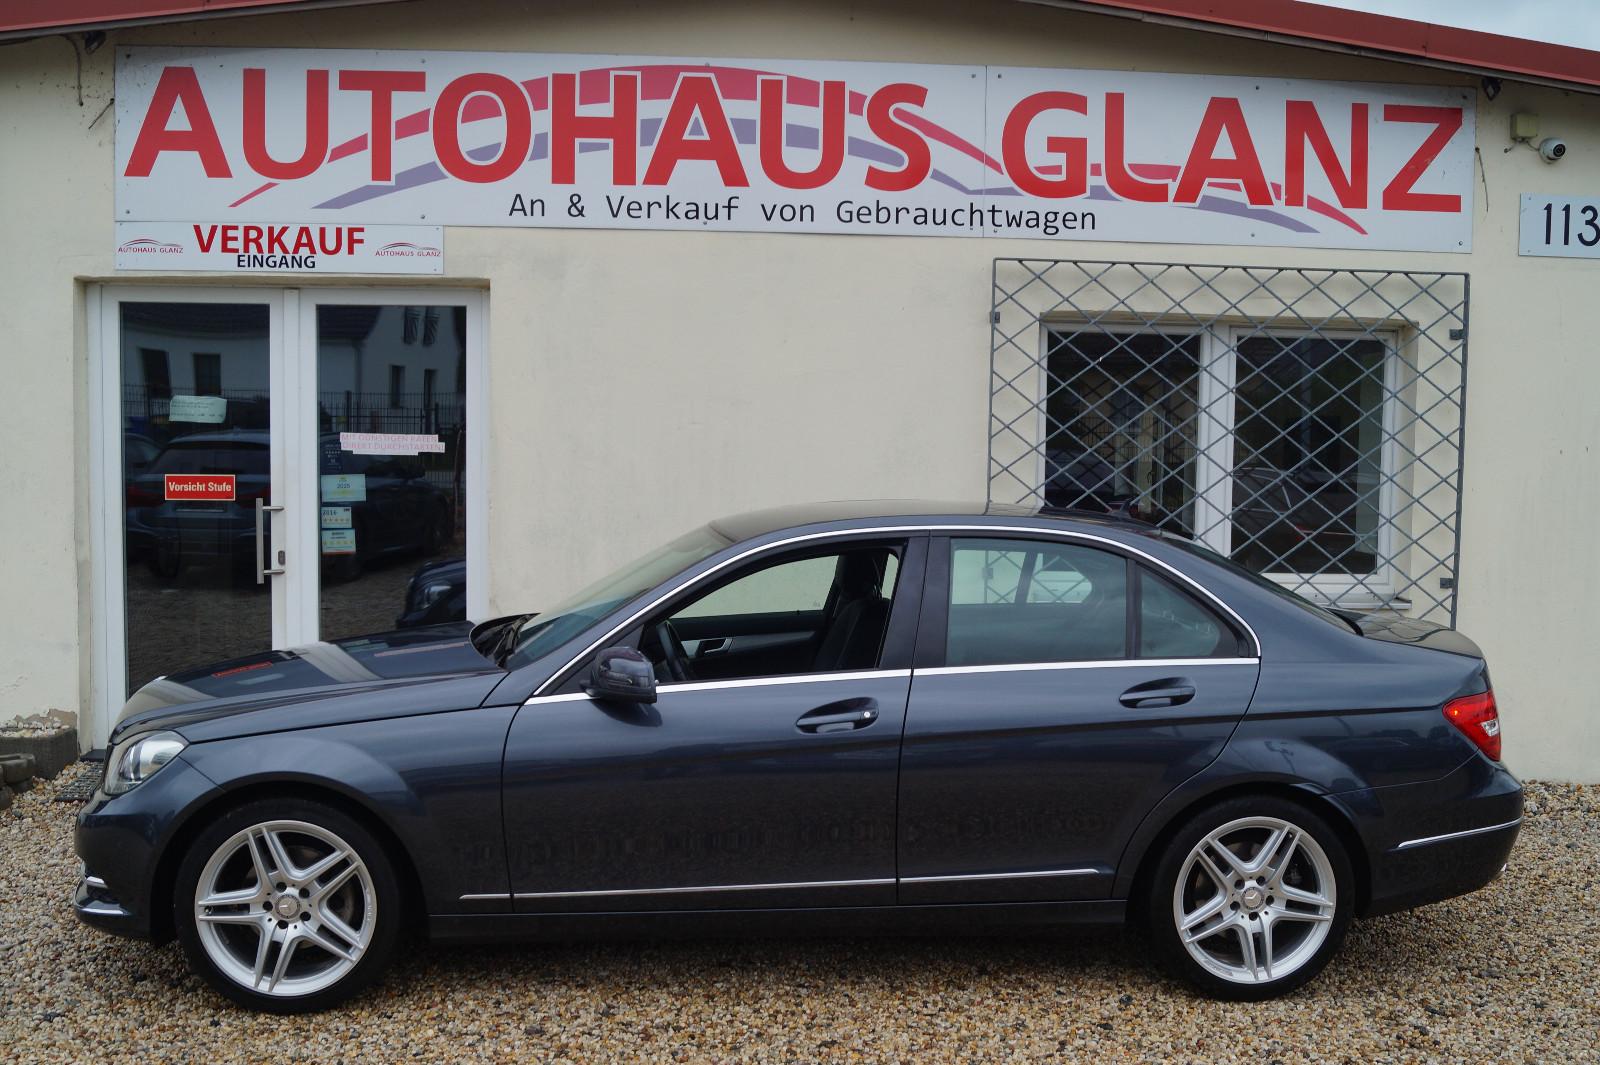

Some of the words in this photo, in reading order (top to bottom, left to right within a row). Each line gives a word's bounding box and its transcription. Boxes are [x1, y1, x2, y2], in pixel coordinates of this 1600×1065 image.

[124, 65, 931, 192] AUTOHAUS
[1001, 91, 1463, 213] GLANZ
[508, 193, 545, 217] An
[567, 194, 585, 218] &
[605, 194, 740, 222] Verkauf
[760, 203, 815, 222] von
[836, 200, 1096, 236] Gebrauchtwagen
[1543, 202, 1600, 247] 113
[117, 246, 157, 254] AUTOHAUS
[193, 224, 365, 256] VERKAUF
[236, 254, 316, 269] EINGANG
[168, 481, 206, 492] Vorsicht
[208, 482, 232, 492] Stufe
